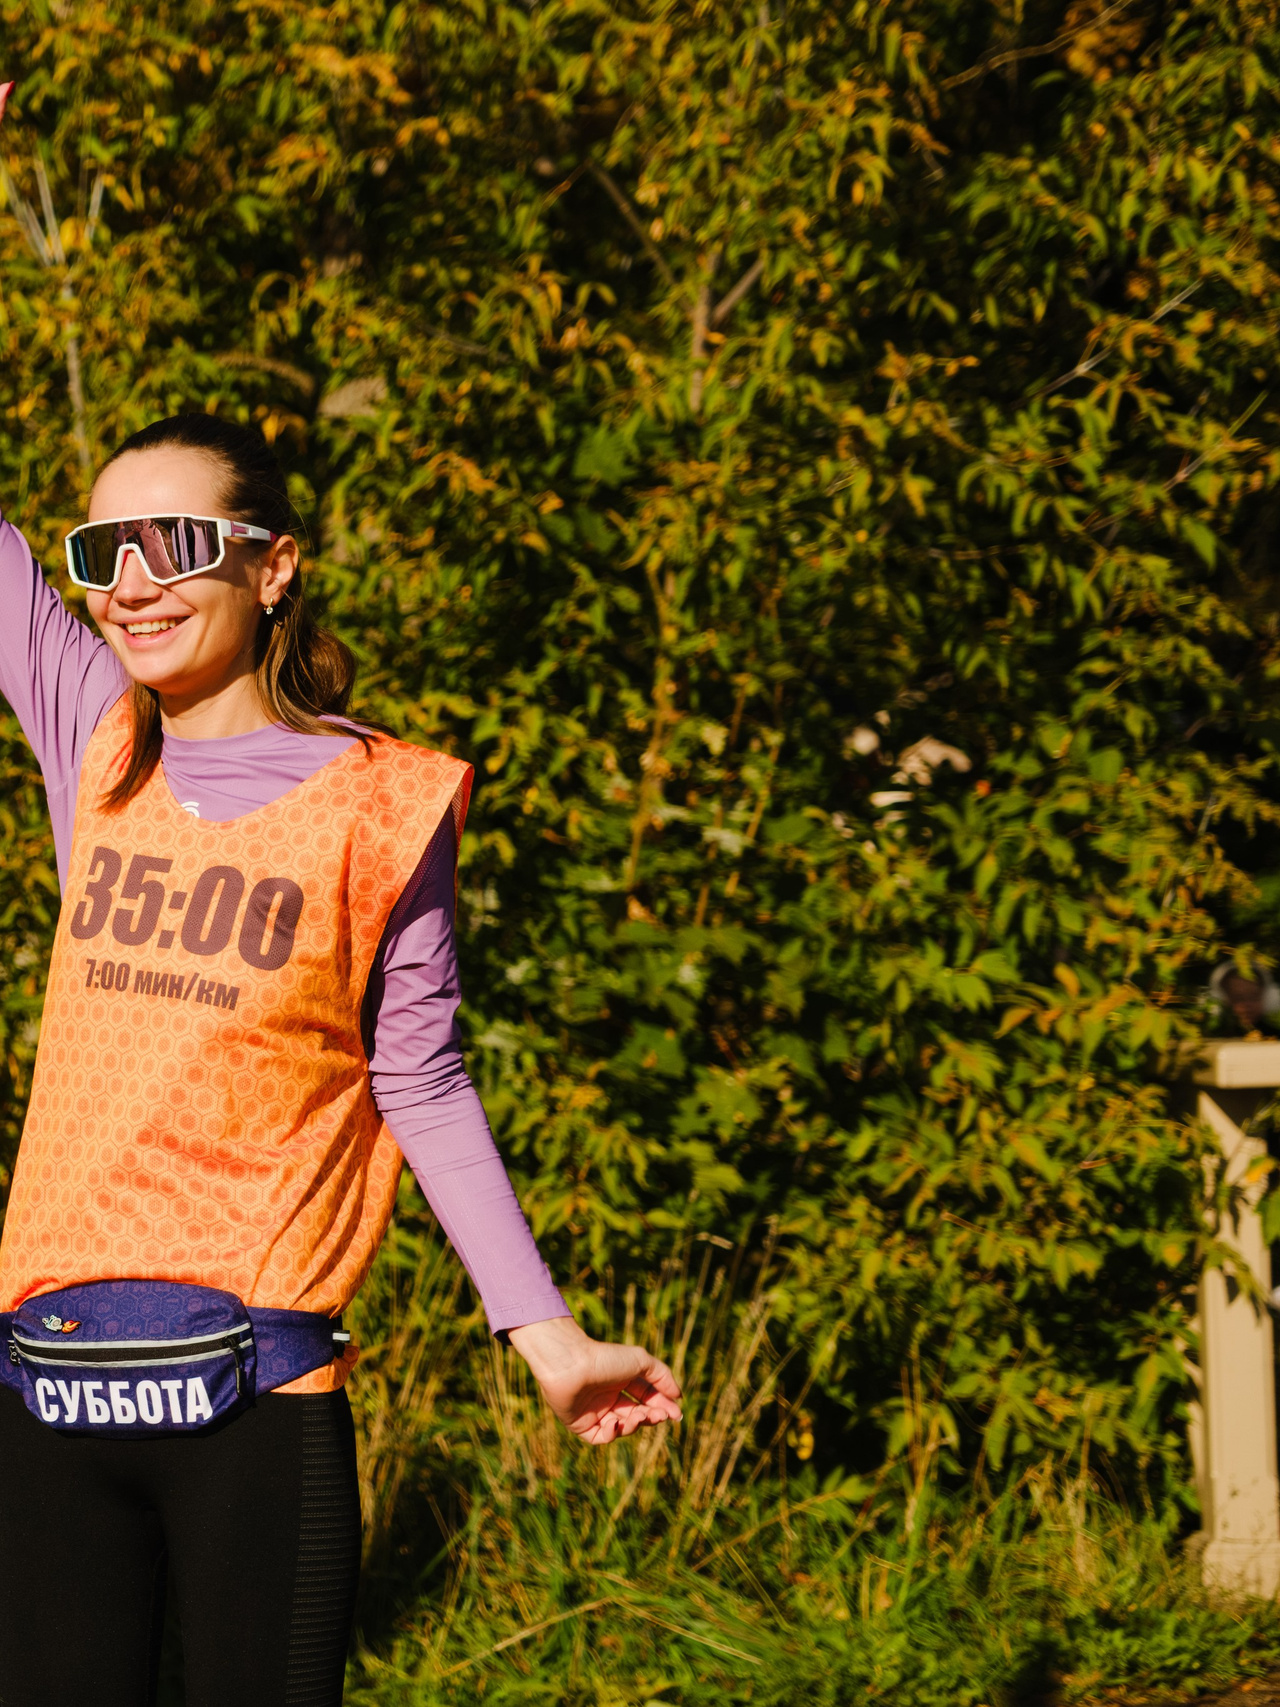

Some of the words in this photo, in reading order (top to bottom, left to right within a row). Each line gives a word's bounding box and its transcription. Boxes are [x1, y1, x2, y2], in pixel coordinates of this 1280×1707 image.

[70, 846, 304, 971] 35:00
[85, 958, 131, 992] 7:00
[35, 1376, 213, 1425] СУББОТА
